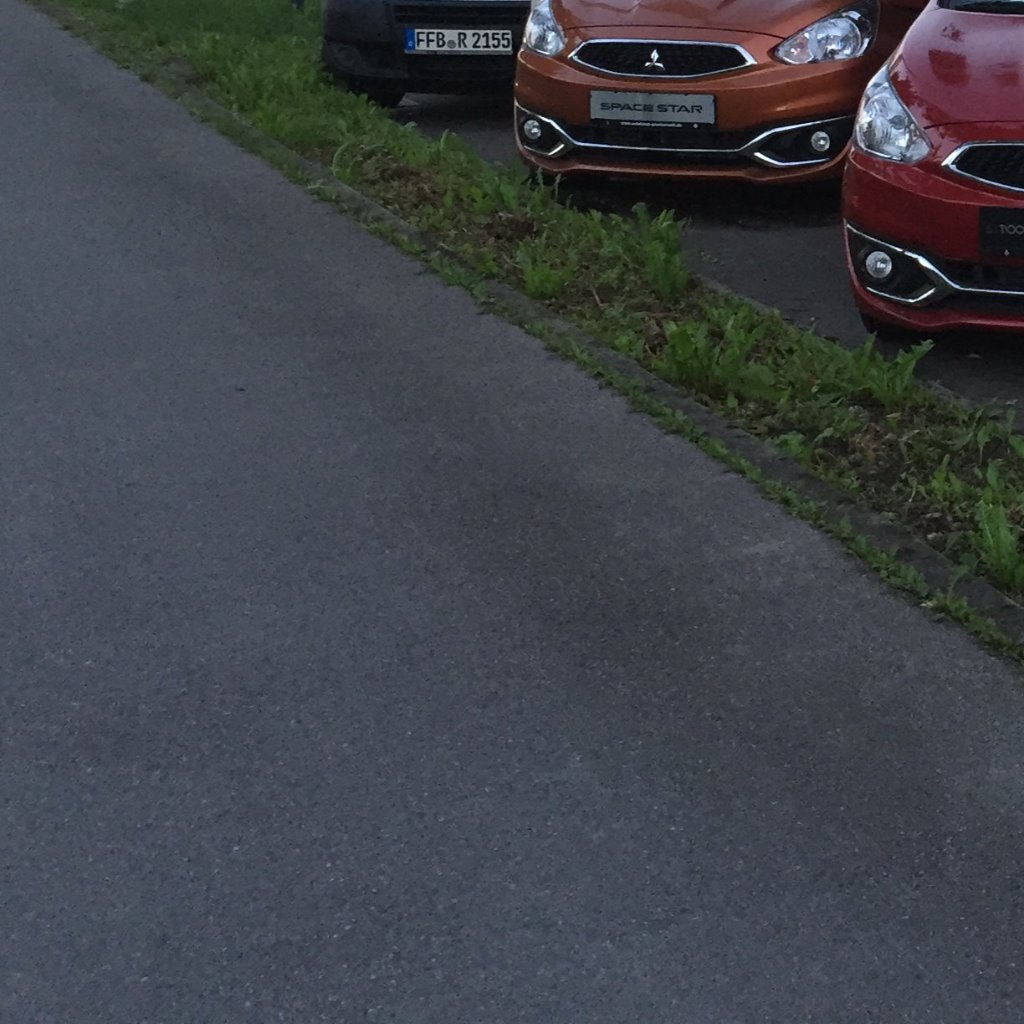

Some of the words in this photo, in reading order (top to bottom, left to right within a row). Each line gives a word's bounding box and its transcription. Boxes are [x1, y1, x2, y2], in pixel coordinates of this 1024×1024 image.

[416, 31, 446, 48] FFB
[457, 32, 468, 49] R
[472, 32, 511, 49] 2155
[599, 102, 654, 113] SPACE
[657, 103, 703, 114] STAR
